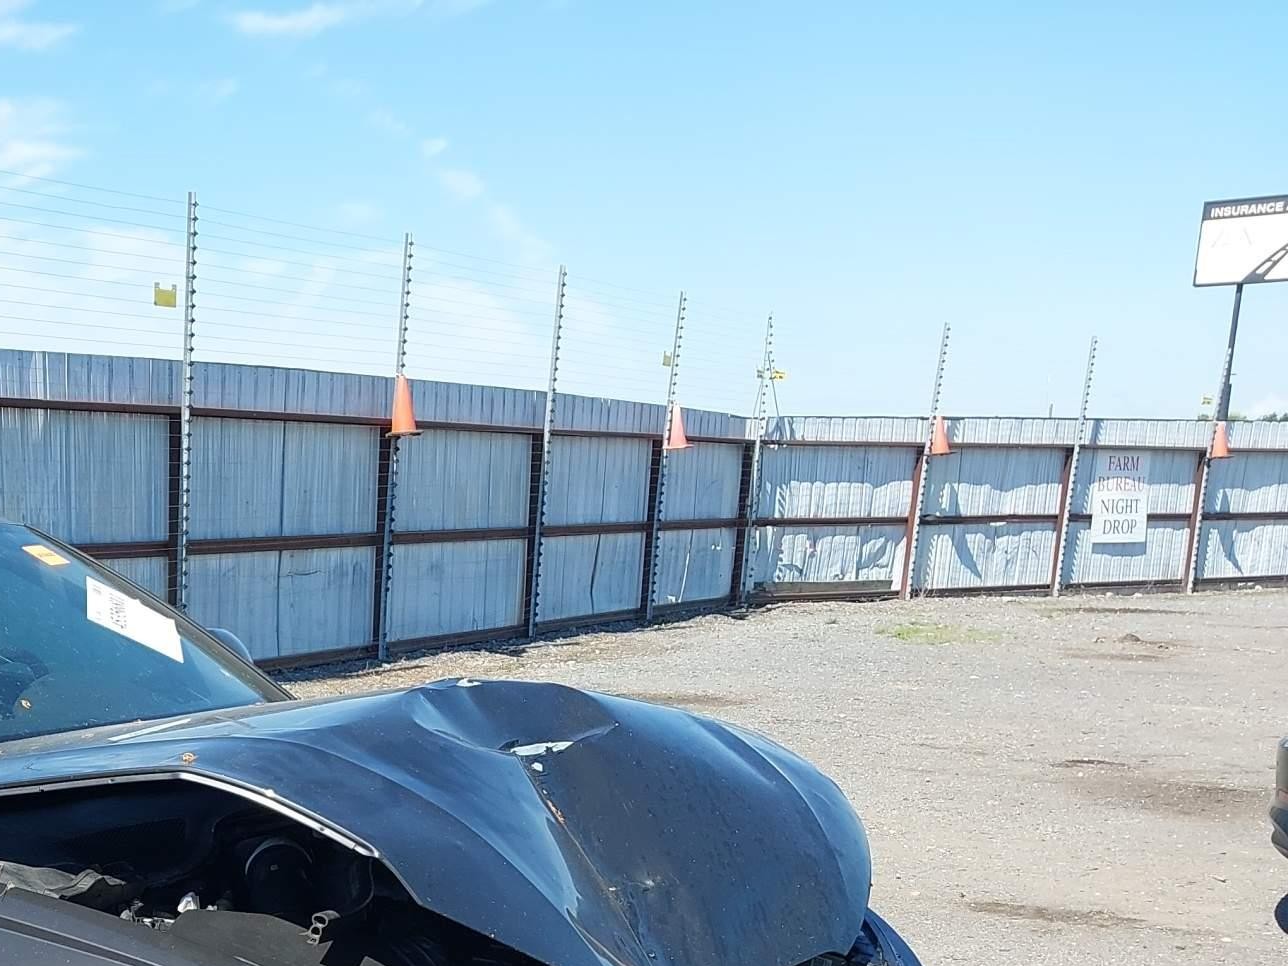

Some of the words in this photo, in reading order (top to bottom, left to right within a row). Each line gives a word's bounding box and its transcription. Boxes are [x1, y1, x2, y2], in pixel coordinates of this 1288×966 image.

[1210, 201, 1285, 218] INSURANCE
[1108, 455, 1140, 472] FARM
[1097, 475, 1145, 492] BUREAU
[1100, 498, 1141, 515] NIGHT
[1102, 518, 1137, 535] DROP
